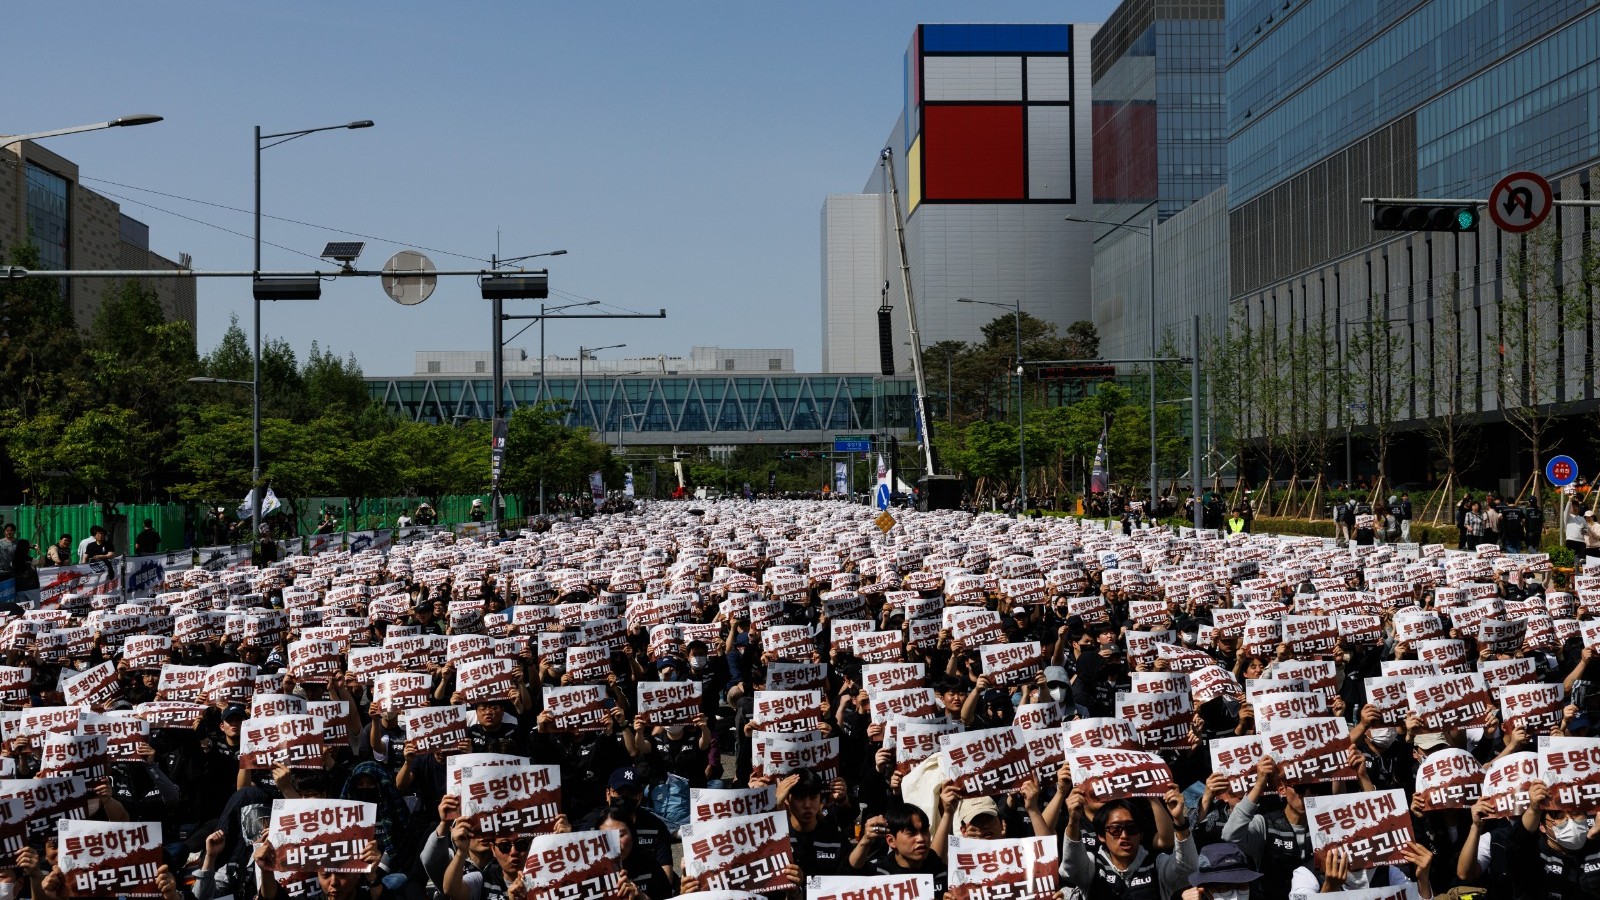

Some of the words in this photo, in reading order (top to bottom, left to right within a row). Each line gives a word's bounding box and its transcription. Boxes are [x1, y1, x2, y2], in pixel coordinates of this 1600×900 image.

[1231, 565, 1257, 574] 투명하게
[1010, 581, 1040, 592] 투명하게
[288, 593, 314, 604] 투명하게
[658, 601, 687, 612] 투명하게
[730, 594, 758, 605] 투명하게
[827, 600, 861, 612] 투명하게
[908, 599, 940, 614] 투명하게
[1071, 598, 1100, 611] 투명하게
[1324, 594, 1356, 605] 투명하게
[31, 610, 62, 620] 투명하게
[516, 607, 550, 620] 투명하게
[752, 602, 783, 615] 투명하게
[1133, 603, 1162, 613] 투명하게
[1454, 607, 1488, 622] 투명하게
[103, 617, 140, 631] 투명하게
[177, 615, 209, 631] 투명하게
[333, 619, 365, 628] 투명하게
[958, 614, 995, 631] 투명하게
[1217, 611, 1250, 624] 투명하게
[1341, 618, 1375, 629] 투명하게
[305, 628, 344, 639] 투명하게
[585, 621, 623, 637] 투명하게
[772, 628, 809, 641] 투명하게
[834, 622, 870, 636] 투명하게
[1287, 618, 1330, 635] 투명하게
[1484, 620, 1525, 637] 투명하게
[127, 638, 165, 653] 투명하게
[450, 638, 490, 653] 투명하게
[542, 634, 576, 648] 투명하게
[857, 632, 896, 648] 투명하게
[964, 629, 1002, 646] 바꾸고!!!
[1293, 636, 1336, 652] 바꾸고!!!
[1347, 631, 1381, 643] 바꾸고!!!
[290, 643, 333, 661] 투명하게
[569, 648, 606, 664] 투명하게
[778, 643, 813, 657] 바꾸고!!!
[863, 648, 901, 663] 바꾸고!!!
[986, 644, 1034, 667] 투명하게
[353, 651, 395, 667] 투명하게
[1170, 657, 1213, 671] 바꾸고!!!
[208, 667, 251, 685] 투명하게
[294, 660, 338, 677] 바꾸고!!!
[460, 663, 506, 683] 투명하게
[573, 665, 610, 679] 바꾸고!!!
[772, 667, 820, 685] 투명하게
[868, 665, 918, 686] 투명하게
[995, 664, 1040, 685] 바꾸고!!!
[1483, 660, 1530, 682] 투명하게
[68, 667, 108, 697] 투명하게
[377, 673, 425, 695] 투명하게
[1191, 670, 1230, 687] 투명하게
[209, 686, 252, 700] 바꾸고!!!
[466, 680, 511, 701] 바꾸고!!!
[642, 684, 694, 705] 투명하게
[1414, 672, 1474, 706] 투명하게
[548, 688, 598, 710] 투명하게
[759, 693, 813, 716] 투명하게
[876, 691, 930, 715] 투명하게
[1505, 686, 1559, 710] 투명하게
[146, 709, 200, 724] 바꾸고!!!
[254, 700, 302, 719] 투명하게
[650, 705, 700, 724] 바꾸고!!!
[1122, 696, 1182, 722] 투명하게
[1260, 695, 1319, 721] 투명하게
[1427, 701, 1486, 729] 바꾸고!!!
[84, 721, 142, 735] 투명하게
[409, 708, 459, 731] 투명하게
[248, 718, 314, 745] 투명하게
[416, 729, 466, 750] 바꾸고!!!
[1070, 723, 1132, 748] 투명하게
[1270, 719, 1340, 754] 투명하게
[45, 737, 99, 761] 투명하게
[256, 743, 321, 767] 바꾸고!!!
[770, 741, 831, 767] 투명하게
[950, 729, 1017, 767] 투명하게
[1076, 753, 1153, 769] 투명하게
[964, 758, 1031, 794] 바꾸고!!!
[1092, 768, 1170, 796] 바꾸고!!!
[469, 768, 550, 804] 투명하게
[278, 805, 364, 835] 투명하게
[480, 802, 558, 833] 바꾸고!!!
[1315, 793, 1396, 834] 투명하게
[65, 825, 148, 859] 투명하게
[692, 816, 776, 863] 투명하게
[1274, 838, 1293, 850] 투쟁
[522, 834, 610, 878] 투명하게
[816, 851, 836, 859] SELU
[75, 862, 158, 894] 바꾸고!!!
[706, 852, 790, 892] 바꾸고!!!
[1130, 877, 1151, 886] SELU
